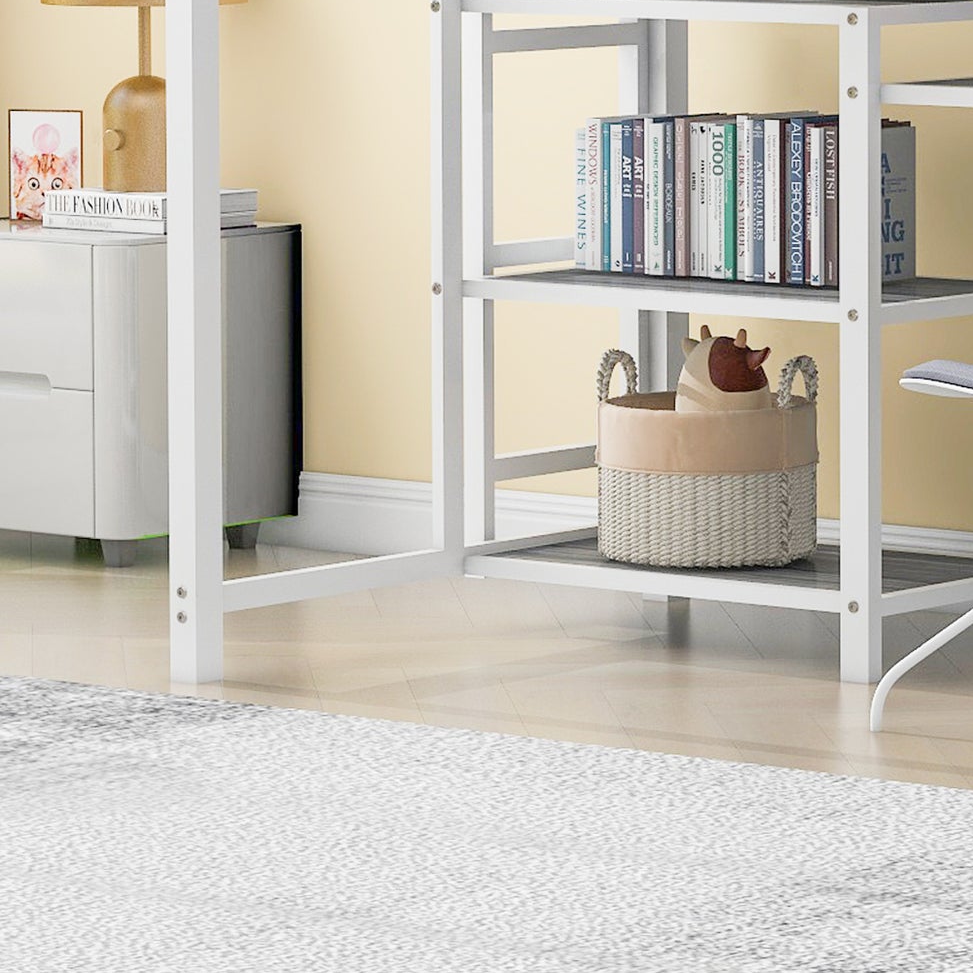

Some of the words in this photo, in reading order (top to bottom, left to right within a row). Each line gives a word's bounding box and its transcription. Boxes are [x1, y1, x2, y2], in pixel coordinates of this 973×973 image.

[577, 148, 586, 185] FINE
[588, 123, 598, 185] WINDOWS
[712, 132, 724, 176] 1000
[791, 121, 801, 178] ALEXEY
[825, 131, 835, 166] LOST
[622, 155, 632, 181] ART
[634, 156, 643, 181] ART
[825, 169, 835, 200] FISH
[46, 194, 71, 213] THE
[73, 195, 123, 215] FASHION
[126, 197, 159, 218] BOOK
[665, 183, 673, 223] BORDEAUX
[755, 161, 764, 241] ANTIQUAIRES
[577, 194, 586, 250] WINES
[791, 181, 803, 274] BRODOVITCH
[884, 252, 905, 275] IT
